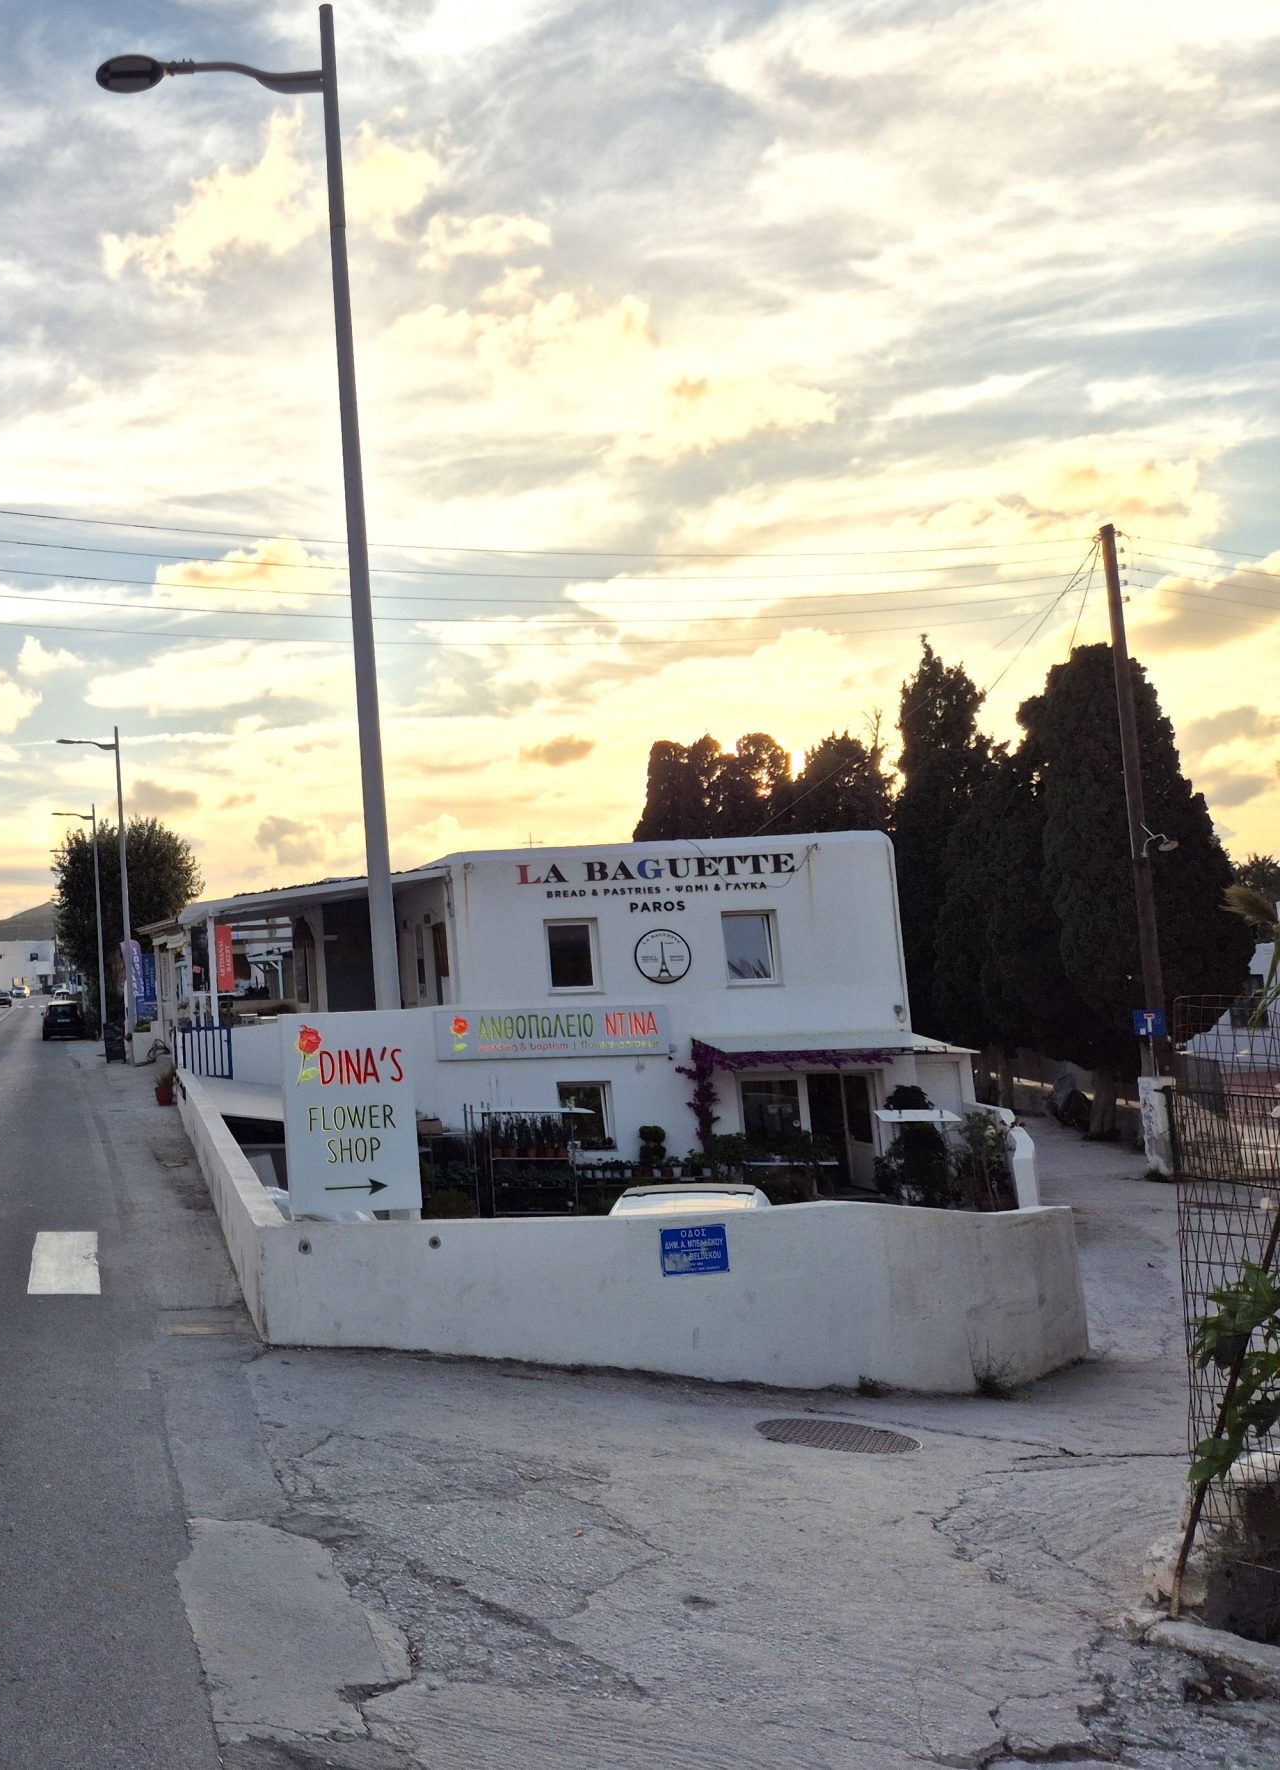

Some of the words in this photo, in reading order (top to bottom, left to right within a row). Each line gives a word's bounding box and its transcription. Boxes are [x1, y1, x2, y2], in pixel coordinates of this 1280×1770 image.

[515, 863, 568, 885] LA
[582, 853, 797, 882] BAGUETTE
[546, 889, 587, 899] BREAD
[591, 888, 599, 897] &
[603, 886, 661, 897] PASTRIES
[674, 884, 709, 893] ΨΩΜΙ
[713, 883, 721, 892] &
[725, 881, 767, 891] ΓΛΥΚΑ
[629, 900, 686, 914] PAROS
[478, 1013, 594, 1040] ΑΝΘΟΠΩΛΕΙΟ
[603, 1011, 659, 1037] ΝΤΙΝΑ
[529, 1042, 569, 1051] baptism
[320, 1046, 404, 1085] DINA'S
[308, 1104, 396, 1132] FLOWER
[327, 1137, 381, 1164] SHOP
[681, 1229, 706, 1237] ΟΔΟΣ
